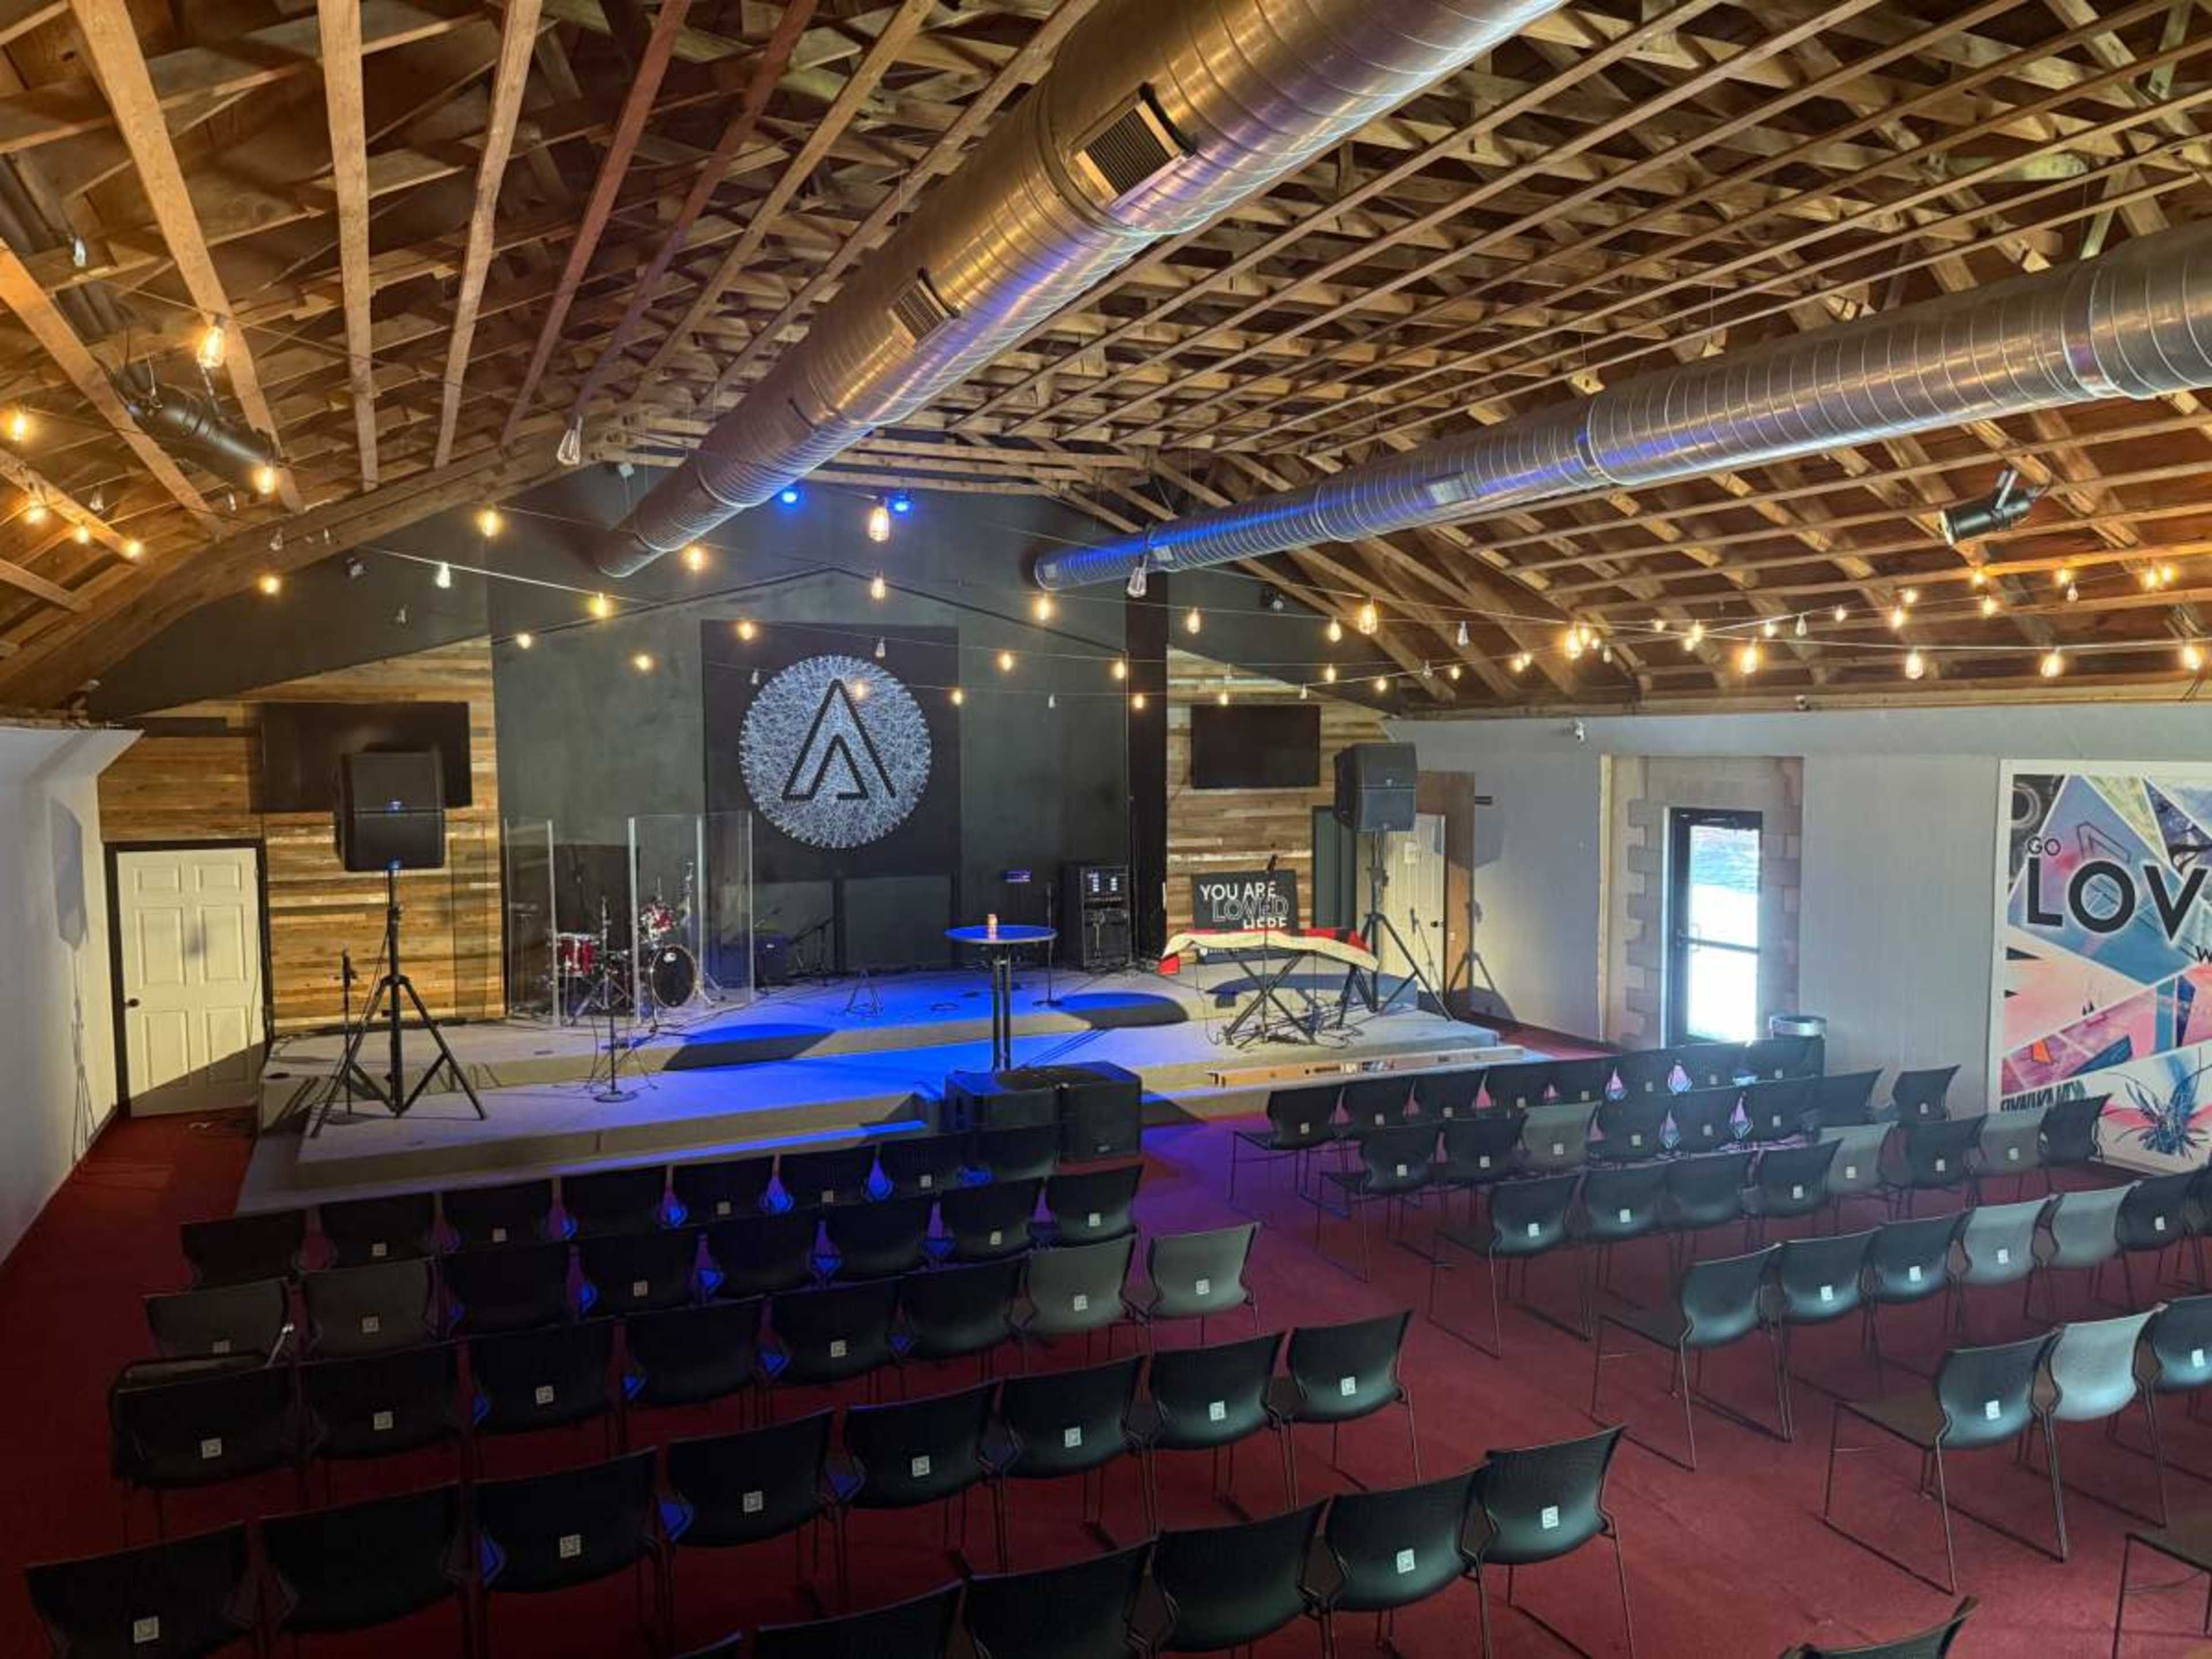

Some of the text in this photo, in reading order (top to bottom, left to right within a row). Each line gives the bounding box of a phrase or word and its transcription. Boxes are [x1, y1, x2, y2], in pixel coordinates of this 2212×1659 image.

[2027, 836, 2061, 856] GO
[1199, 881, 1277, 901] YOU ARE
[1212, 895, 1289, 922] LOVED
